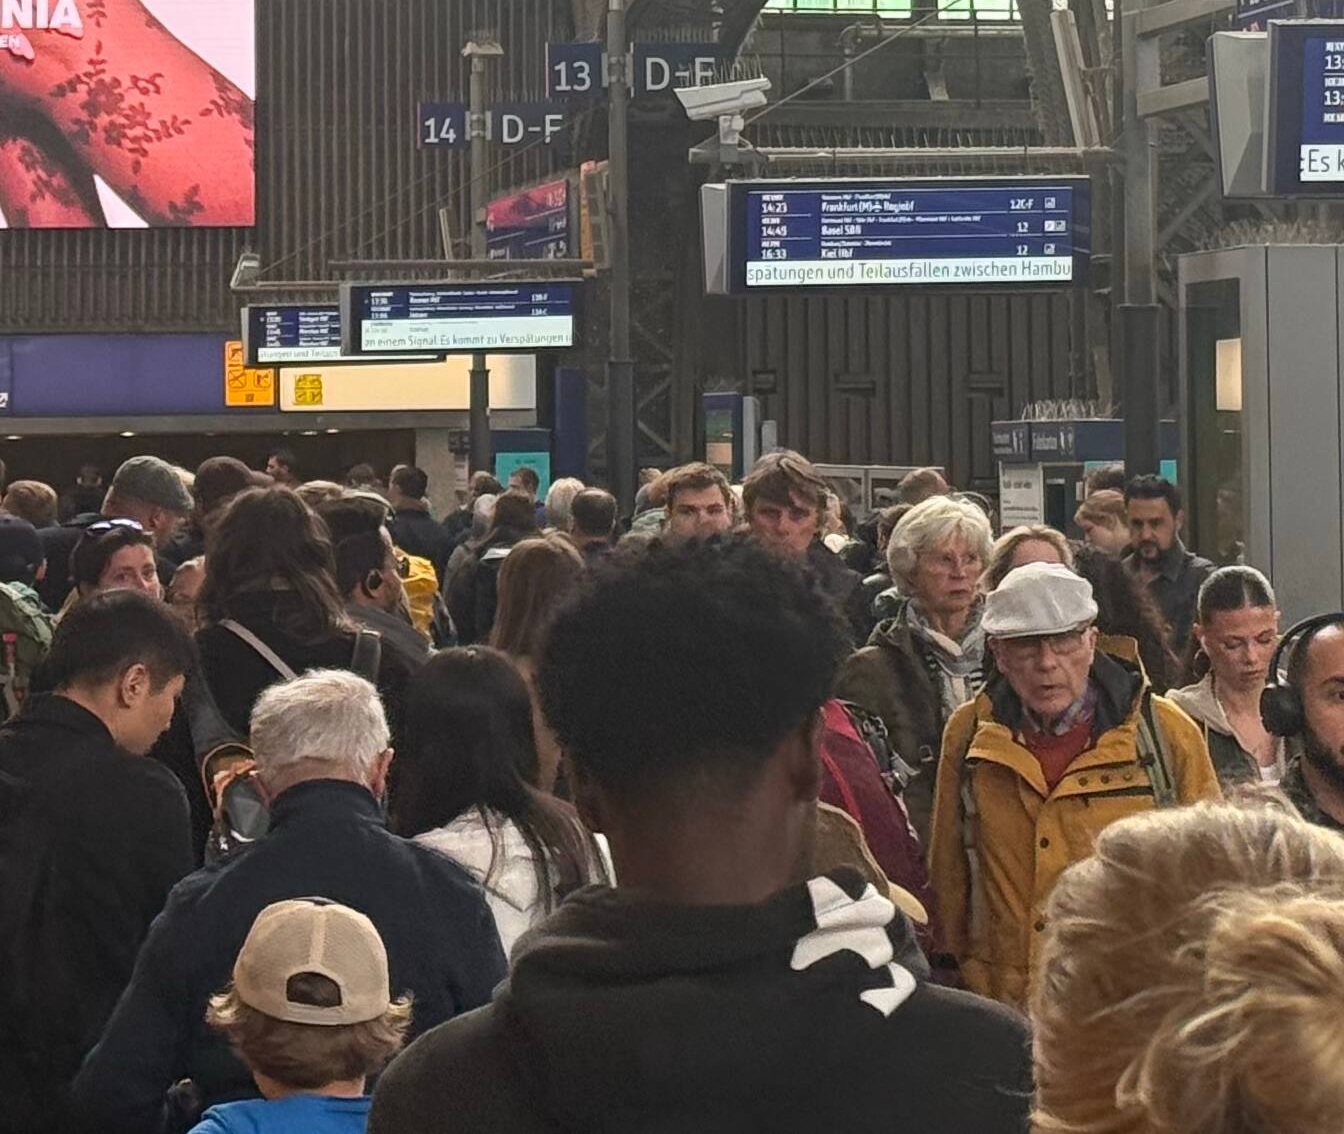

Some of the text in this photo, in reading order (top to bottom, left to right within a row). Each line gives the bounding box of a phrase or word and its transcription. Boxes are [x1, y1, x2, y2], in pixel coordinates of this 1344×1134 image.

[553, 56, 716, 92] 13 D-F
[423, 114, 563, 144] 14 D-F
[1307, 148, 1330, 173] Es
[1016, 221, 1029, 233] 12
[1016, 244, 1029, 256] 12
[827, 263, 855, 279] und
[955, 262, 1018, 278] zwischen
[1021, 260, 1071, 277] Hambu
